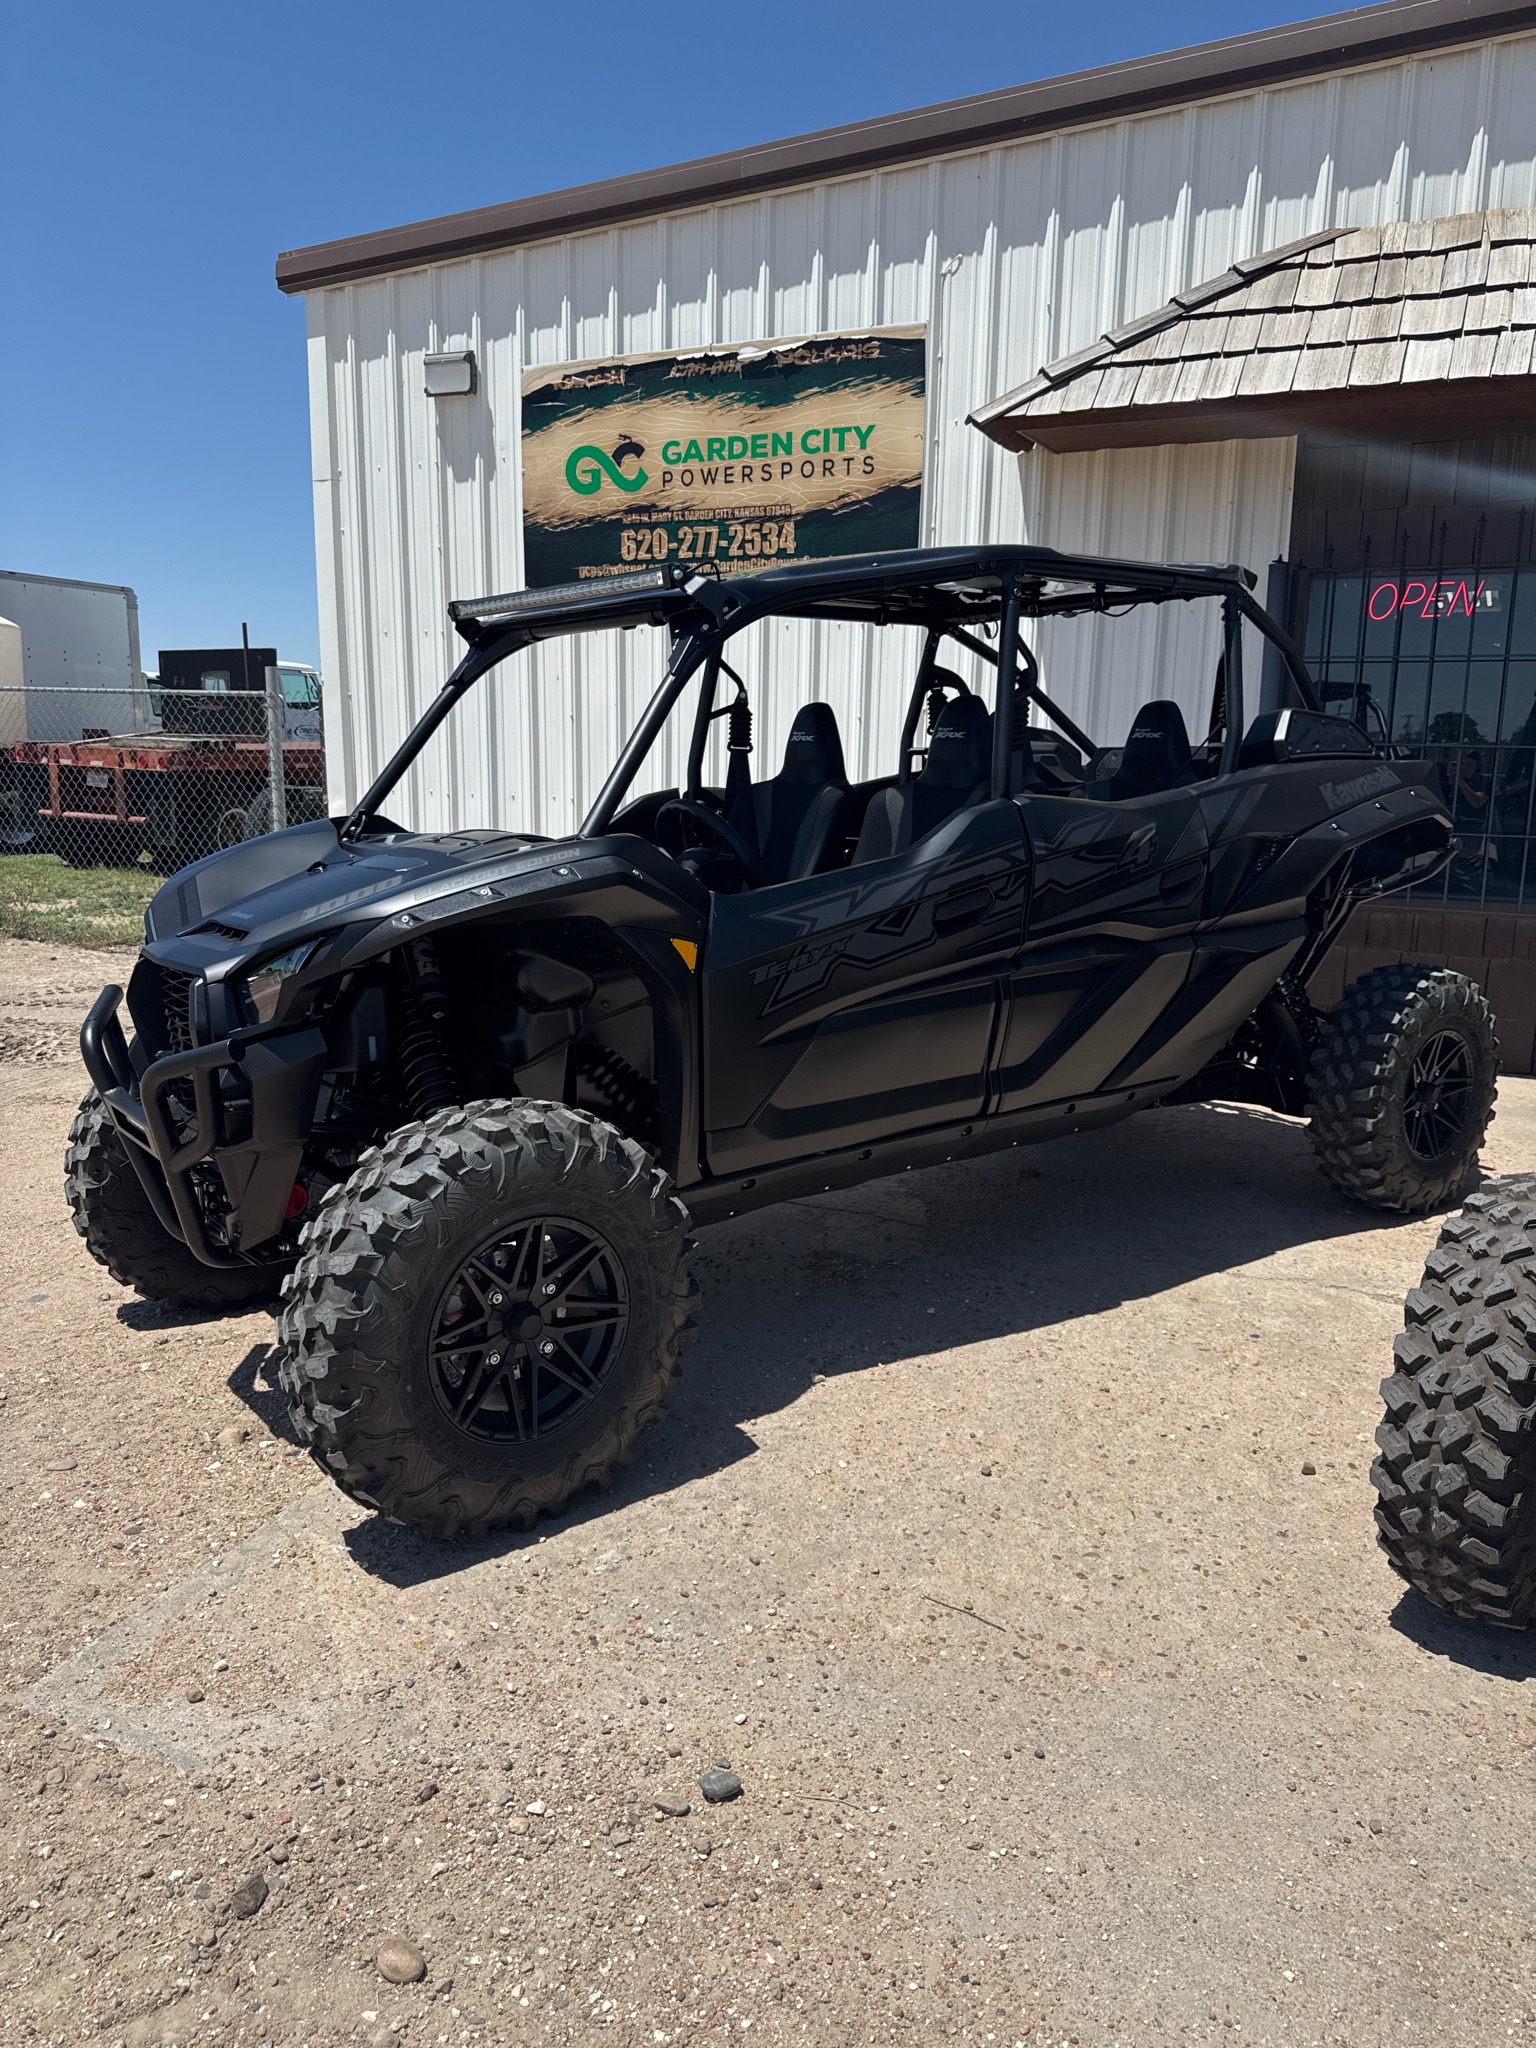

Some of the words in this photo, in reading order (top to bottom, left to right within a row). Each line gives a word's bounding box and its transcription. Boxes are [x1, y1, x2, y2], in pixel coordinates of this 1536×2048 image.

[661, 431, 793, 465] GARDEN
[800, 424, 876, 455] CITY
[663, 455, 875, 488] POWERSPORTS
[684, 508, 714, 521] GARDEN
[734, 506, 765, 518] KANSAS
[620, 521, 796, 562] 620-277-2534
[1368, 579, 1486, 621] OPEN
[1318, 765, 1402, 811] Kawasaki
[414, 865, 509, 902] BLACKOUT
[515, 847, 581, 872] EDITION
[300, 874, 404, 922] 1000
